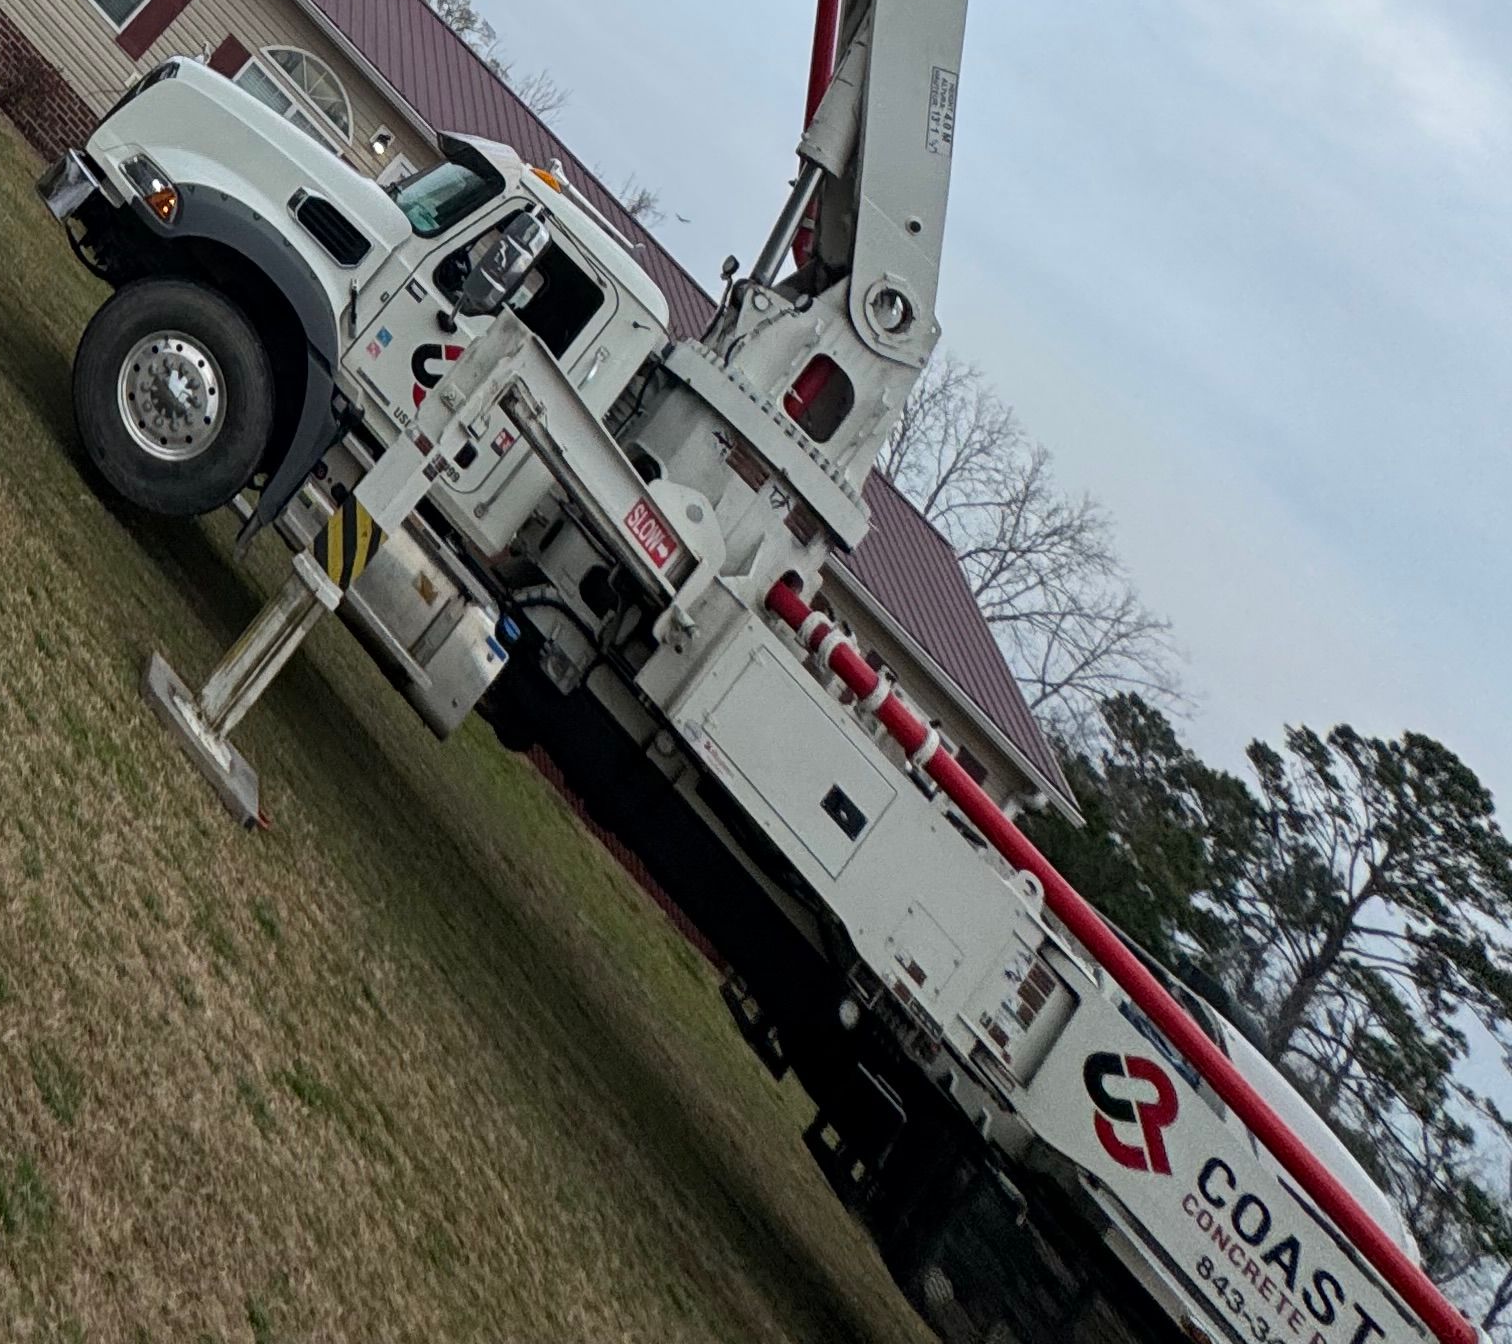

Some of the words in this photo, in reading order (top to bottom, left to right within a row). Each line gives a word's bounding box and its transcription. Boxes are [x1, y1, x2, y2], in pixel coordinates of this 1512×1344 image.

[627, 503, 665, 552] SLOW
[1182, 1193, 1306, 1335] CONCRETE
[1197, 1157, 1386, 1344] COAST
